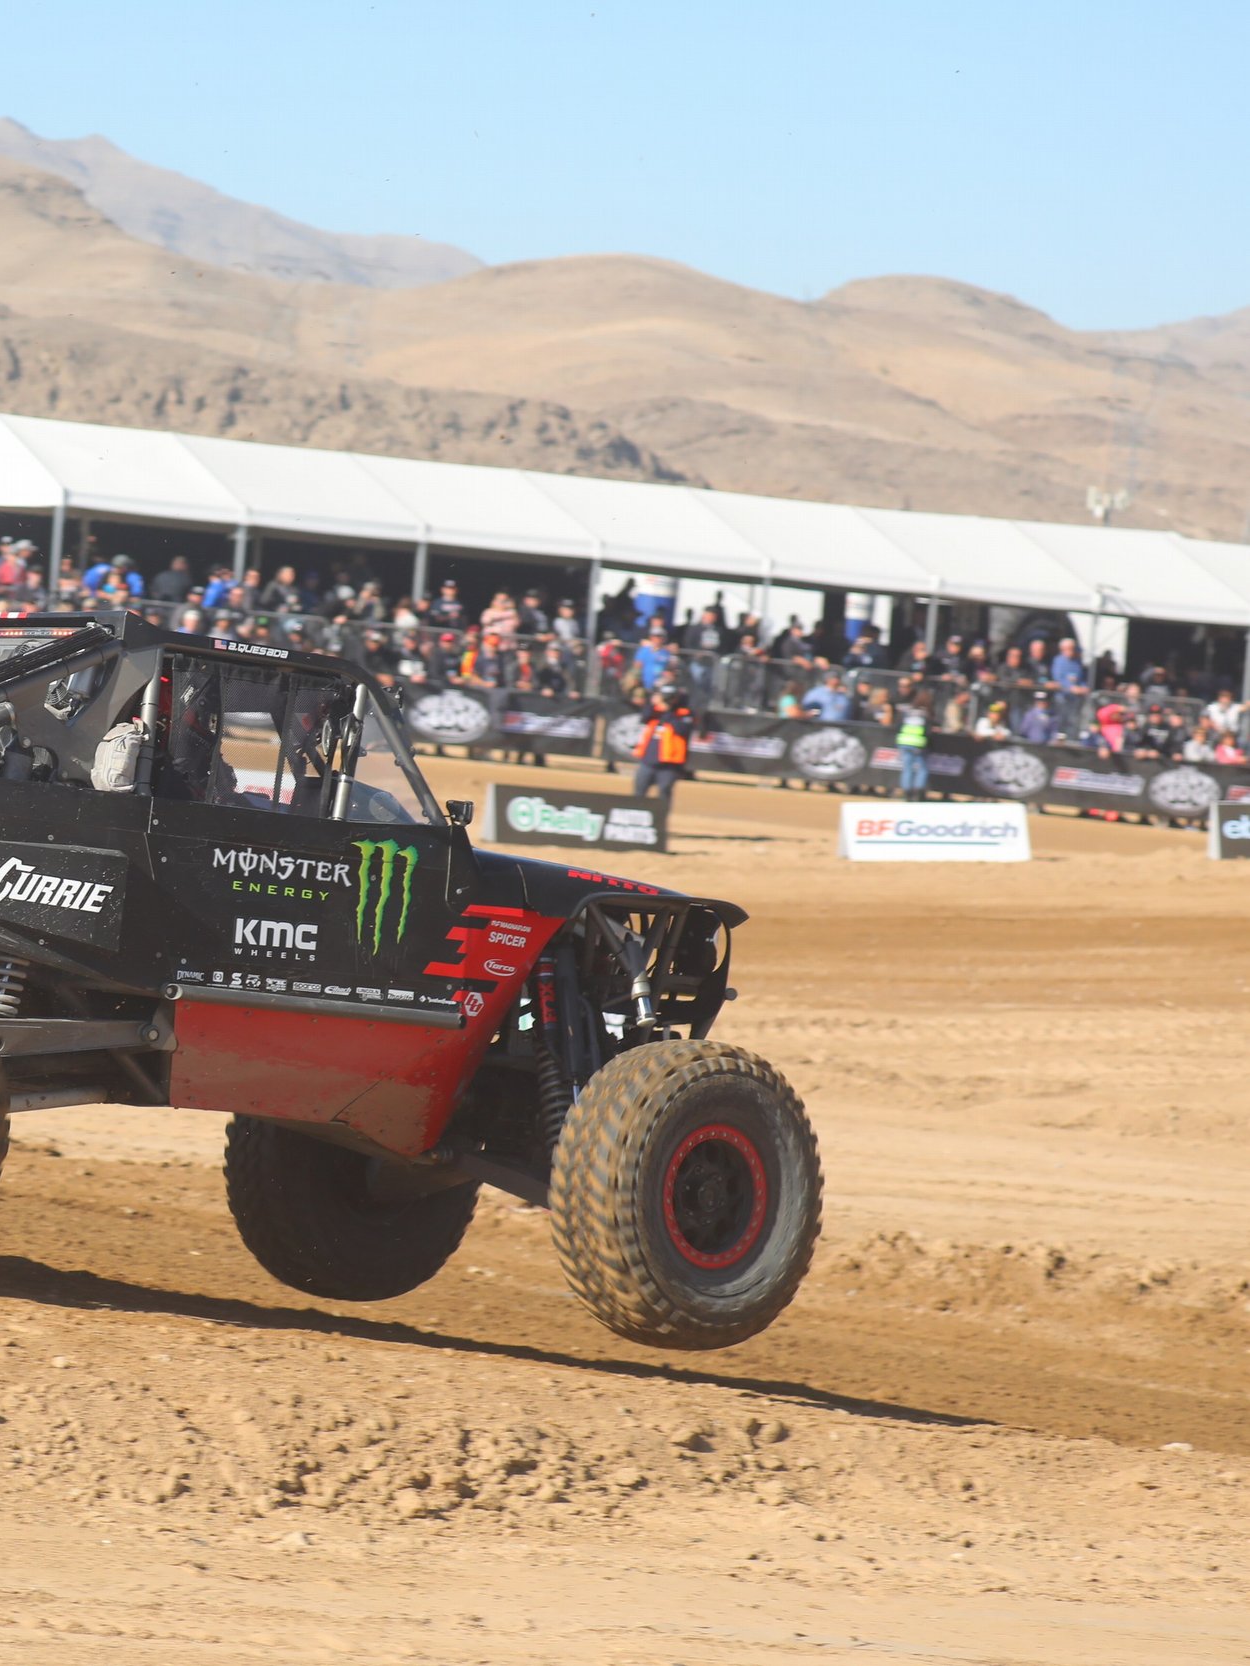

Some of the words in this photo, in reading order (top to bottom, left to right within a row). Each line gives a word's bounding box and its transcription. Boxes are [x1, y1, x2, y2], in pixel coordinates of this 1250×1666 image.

[856, 819, 1019, 839] BFGoodrich
[212, 847, 352, 887] MONSTER
[232, 880, 329, 901] ENERGY
[568, 870, 659, 896] NITTO
[488, 931, 526, 949] SPICER
[234, 948, 316, 962] WHEELS
